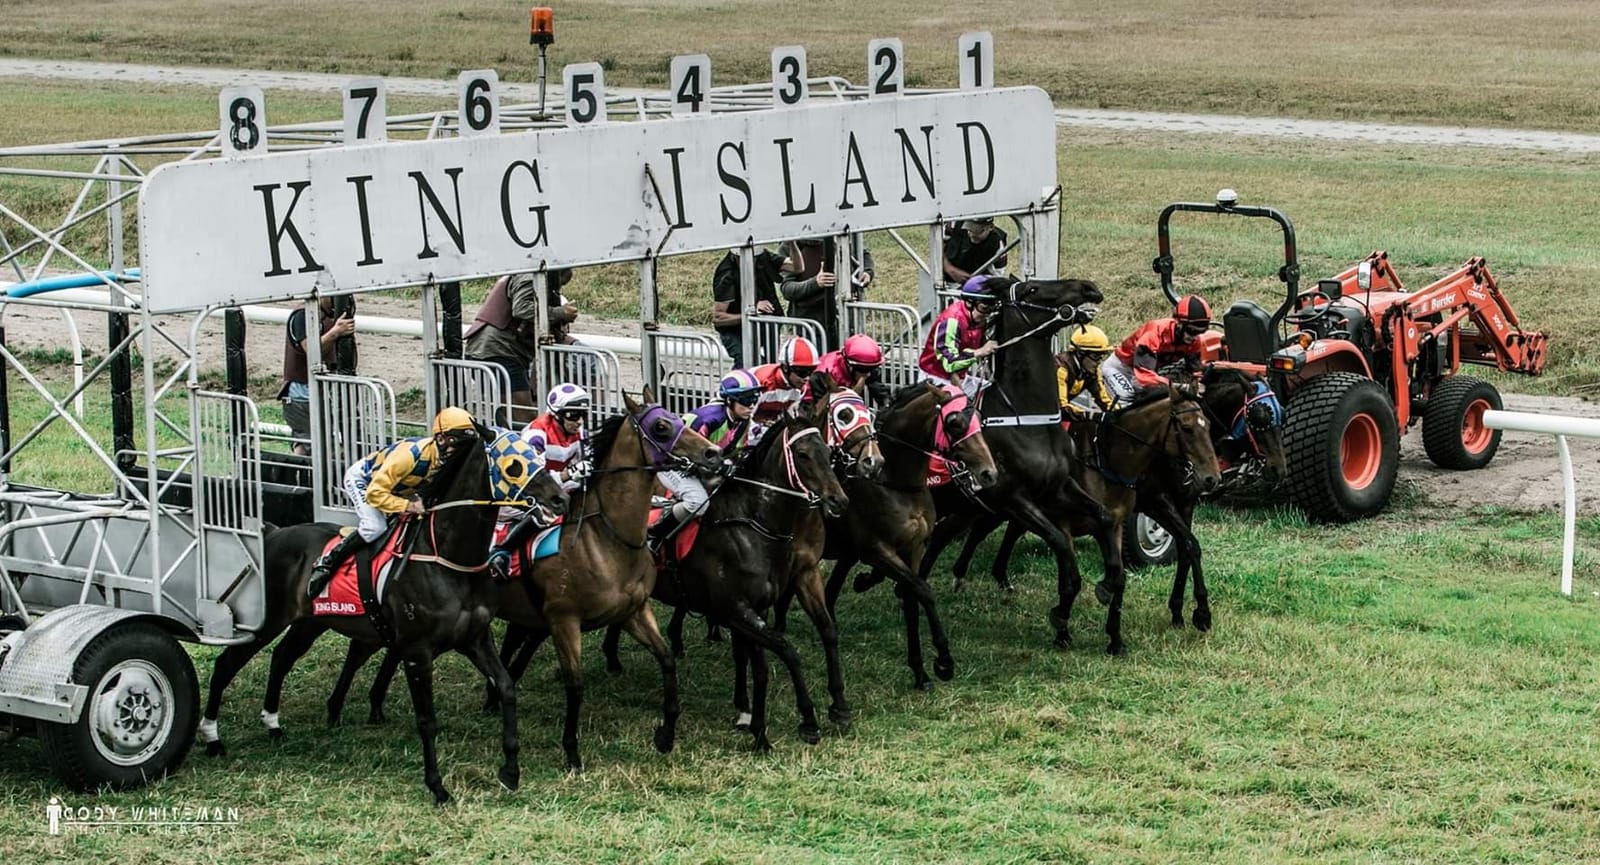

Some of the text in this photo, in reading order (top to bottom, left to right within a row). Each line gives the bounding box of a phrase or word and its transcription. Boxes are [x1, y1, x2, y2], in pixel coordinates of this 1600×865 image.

[677, 66, 704, 112] 4
[779, 56, 802, 104] 3
[875, 47, 897, 94] 2
[967, 41, 982, 88] 1
[350, 86, 378, 140] 7
[465, 78, 491, 130] 6
[571, 73, 597, 123] 5
[229, 97, 259, 151] 8
[253, 121, 996, 278] KING ISLAND
[315, 602, 356, 613] KING ISLAND
